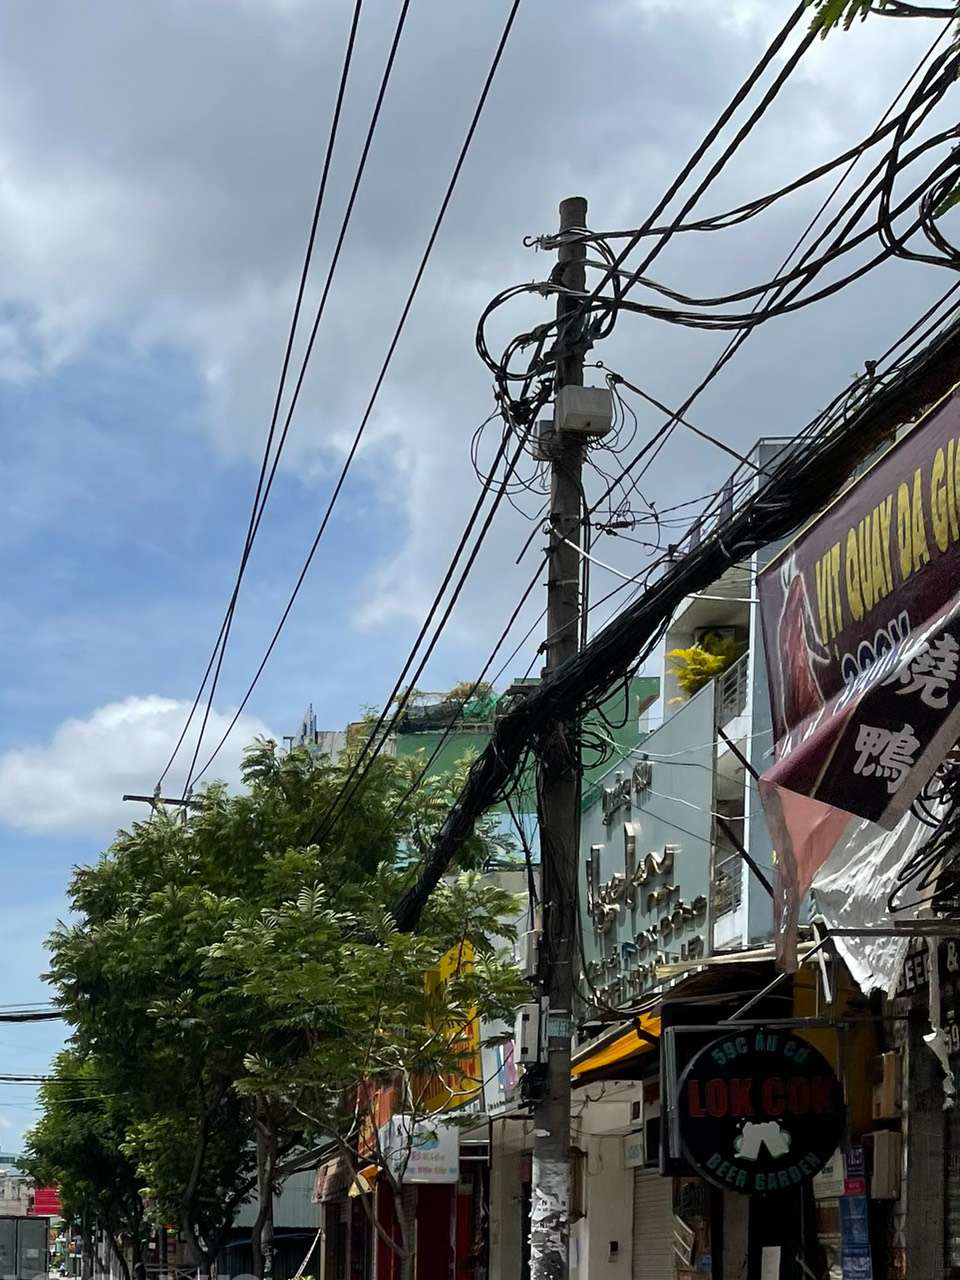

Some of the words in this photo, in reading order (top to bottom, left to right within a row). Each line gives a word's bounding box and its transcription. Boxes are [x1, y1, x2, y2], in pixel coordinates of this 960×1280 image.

[846, 494, 894, 622] QUAY
[931, 437, 960, 553] GI
[705, 1152, 750, 1188] BEER
[754, 1151, 821, 1190] GARDEN
